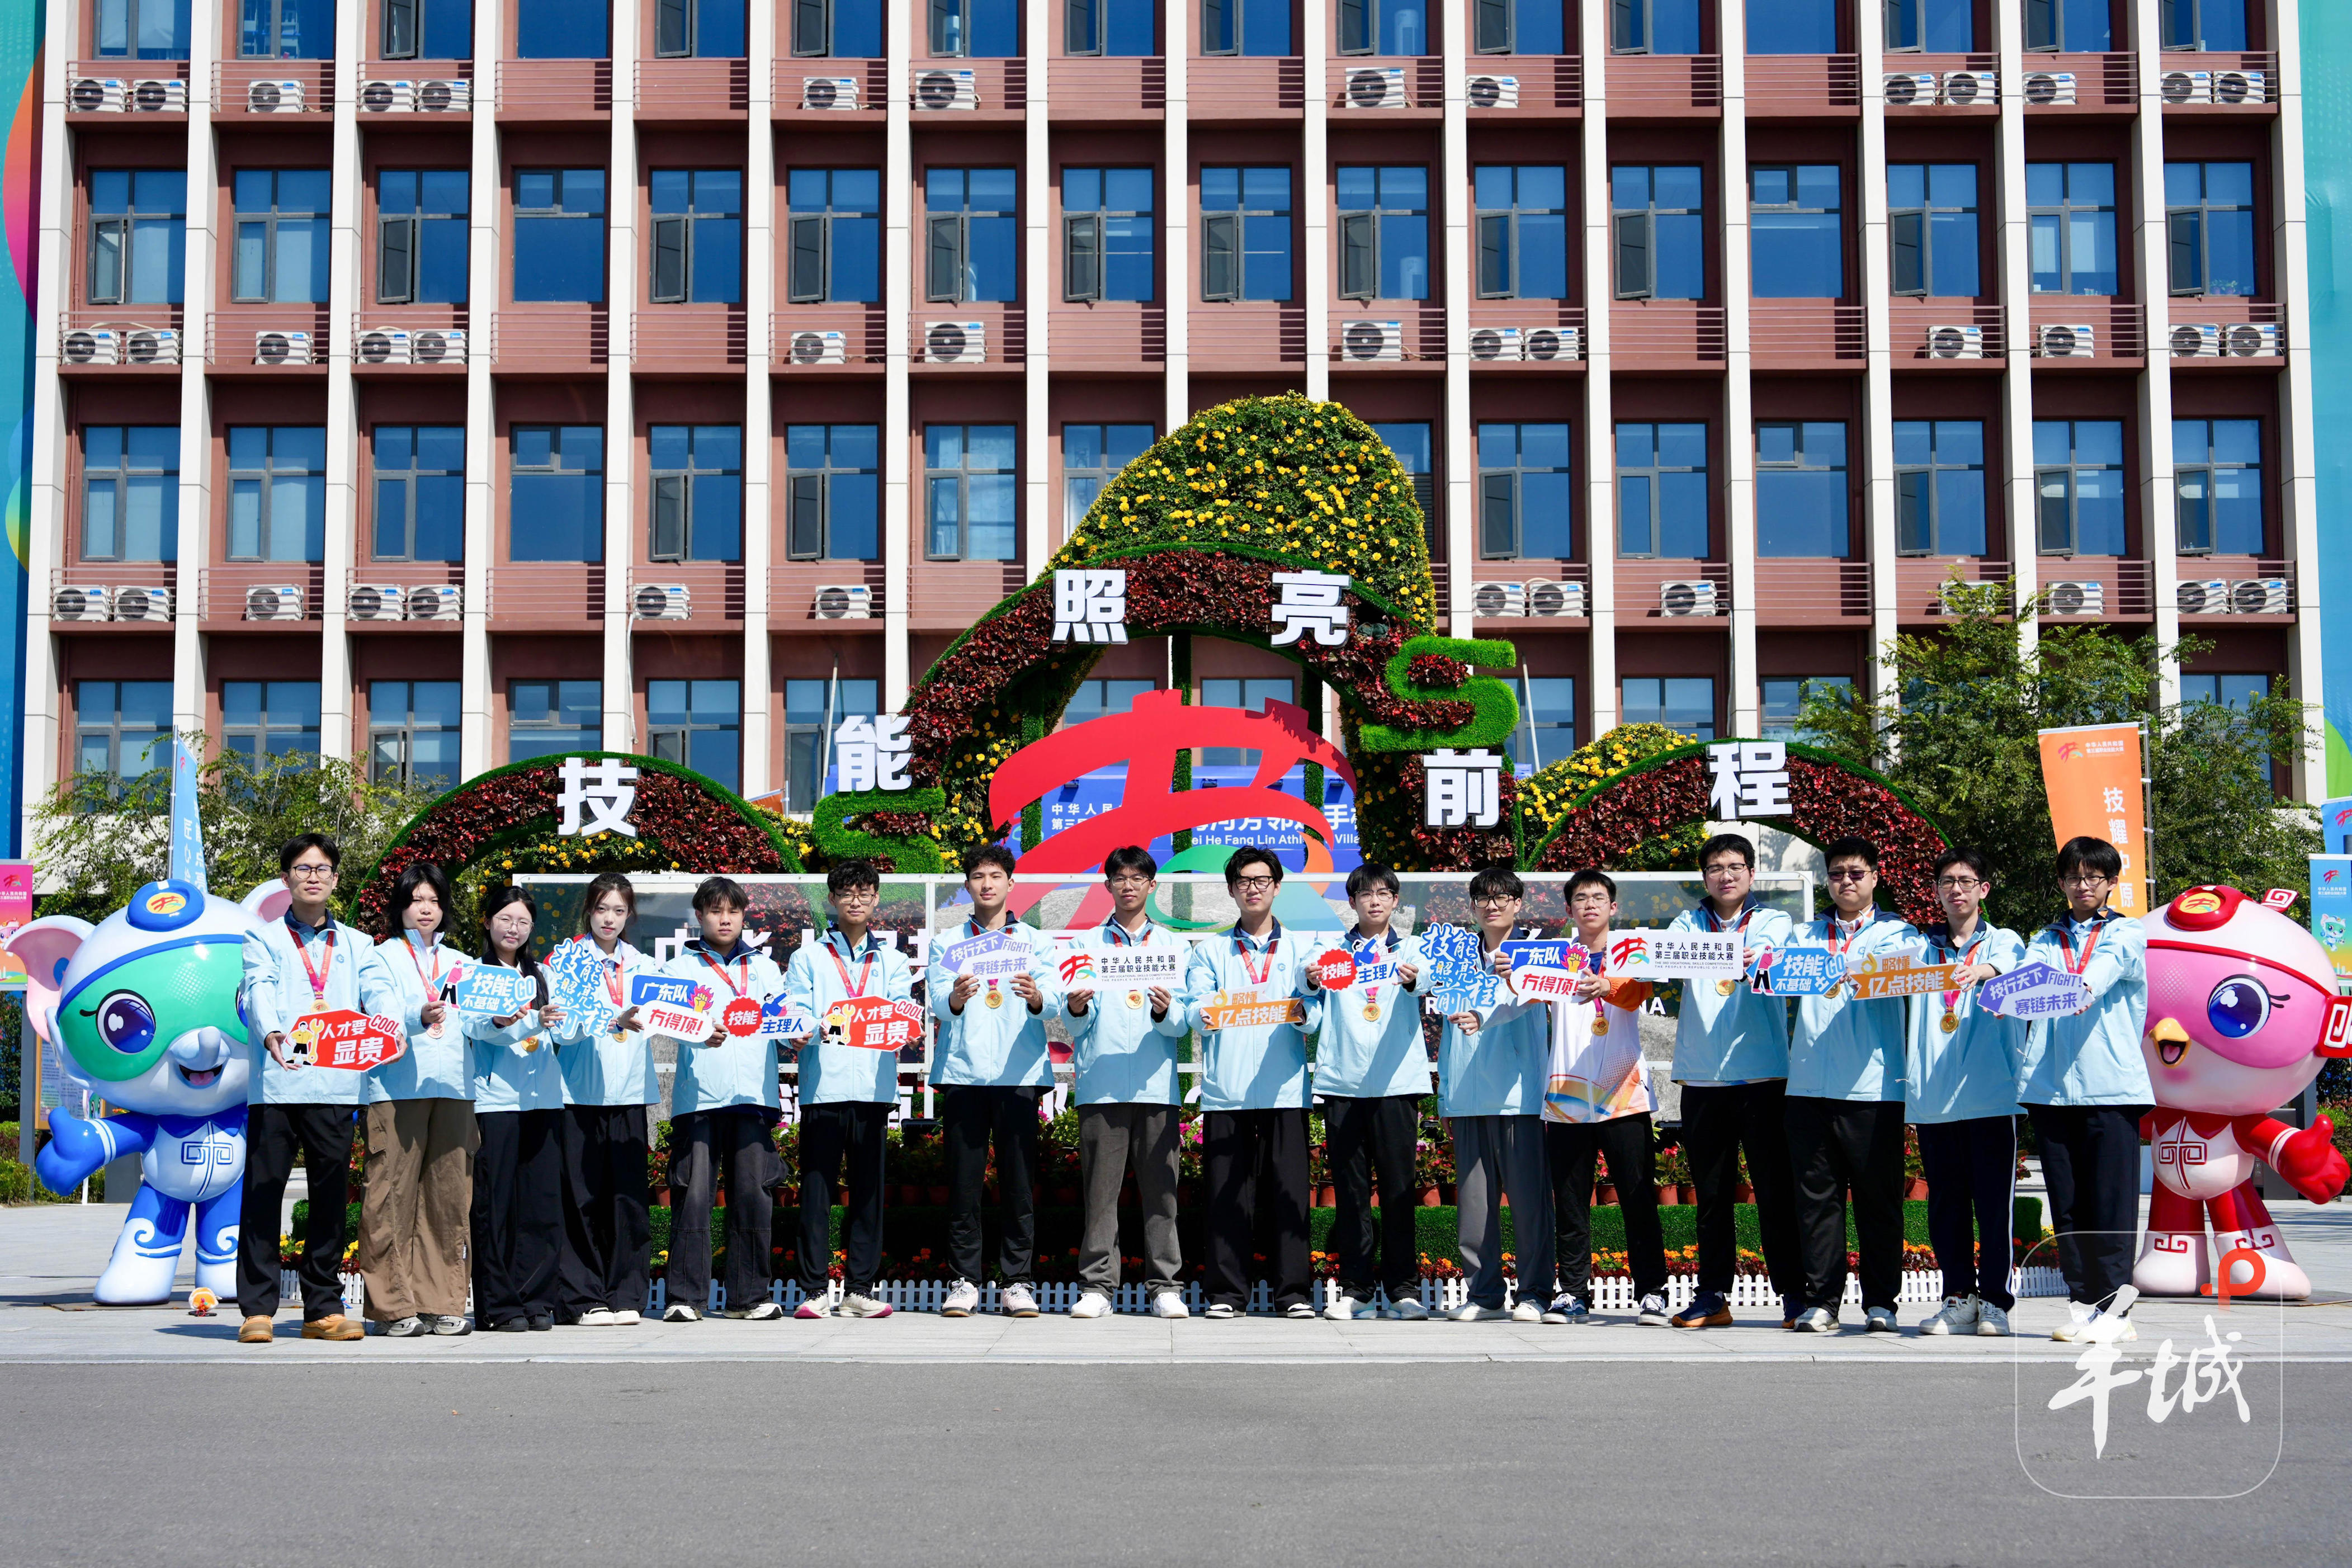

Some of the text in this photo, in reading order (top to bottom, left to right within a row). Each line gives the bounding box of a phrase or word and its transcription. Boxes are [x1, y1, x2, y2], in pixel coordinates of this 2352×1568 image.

[1206, 835, 1221, 845] He
[1225, 835, 1254, 846] Fang
[1258, 834, 1275, 844] Lin
[2103, 787, 2134, 908] 技耀中原
[951, 935, 998, 962] 技行天下
[1002, 941, 1033, 953] FIGHT!
[1421, 925, 1477, 962] 技能
[1655, 942, 1734, 951] 中华人民共和国
[551, 940, 602, 984] 技能
[1101, 955, 1175, 965] 中华人民共和国
[1510, 947, 1560, 965] 广东队
[1655, 951, 1734, 960] 第三届职业技能大赛
[1783, 955, 1825, 976] 技能
[1828, 954, 1844, 976] GO
[1882, 955, 1910, 971] 略懂
[972, 957, 1027, 975] 赛链未来
[1101, 964, 1176, 974] 第三届职业技能大赛
[1322, 961, 1352, 980] 技能
[1358, 962, 1400, 984] 主理人
[1432, 958, 1473, 983] 照亮
[471, 972, 516, 997] 技能
[517, 979, 535, 999] GO
[1775, 978, 1812, 991] 不基础
[1868, 970, 1944, 997] 亿点技能
[1989, 967, 2043, 1000] 技行天下
[2048, 973, 2081, 988] FIGHT!
[461, 994, 500, 1011] 不基础
[556, 979, 594, 1009] 照亮
[640, 983, 688, 1003] 广东队
[1232, 991, 1257, 1005] 略懂
[1434, 974, 1498, 1012] 前程
[853, 1004, 894, 1023] 人才要
[896, 1001, 923, 1019] COOL
[2015, 992, 2077, 1015] 赛链未来
[371, 1014, 400, 1035] COOL
[728, 1010, 759, 1026] 技能
[761, 1018, 804, 1034] 主理人
[1218, 1005, 1286, 1028] 亿点技能
[321, 1019, 367, 1040] 人才要
[863, 1021, 909, 1046] 显贵
[332, 1037, 384, 1065] 显贵
